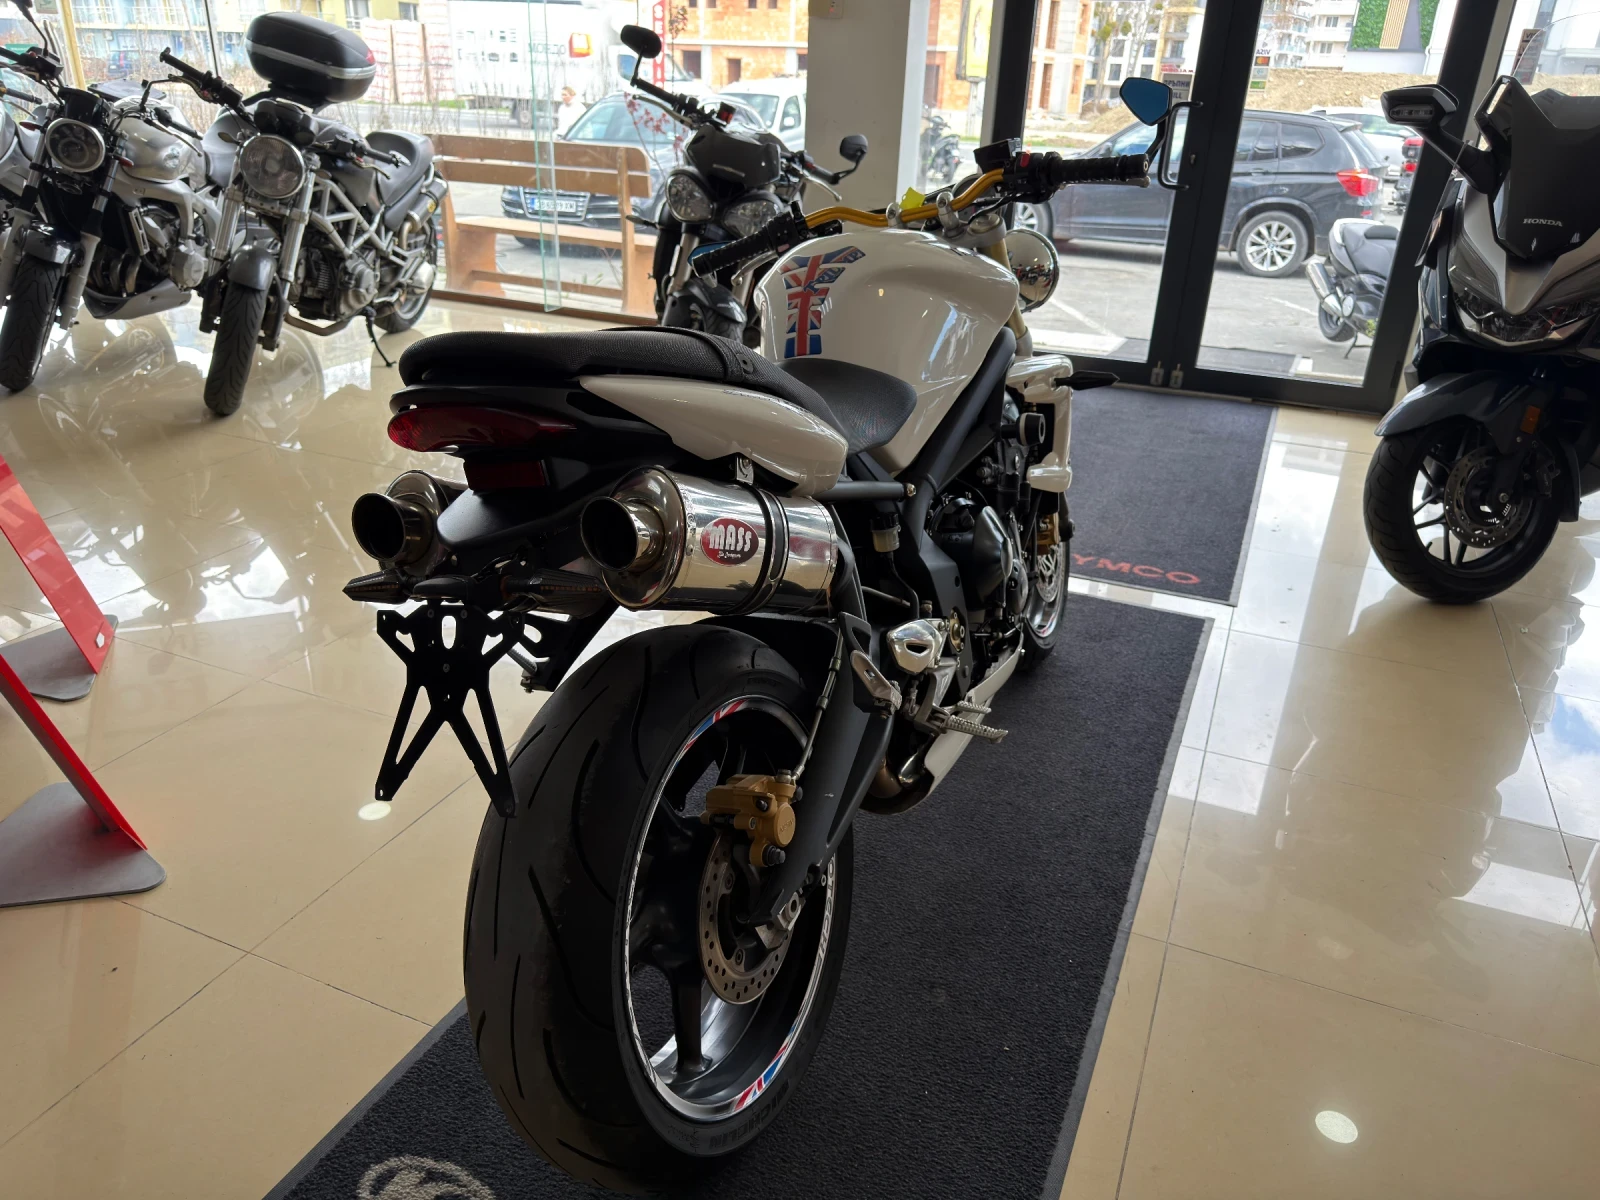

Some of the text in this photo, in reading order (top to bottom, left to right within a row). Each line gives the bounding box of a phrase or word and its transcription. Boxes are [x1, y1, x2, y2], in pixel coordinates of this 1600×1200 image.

[1523, 218, 1563, 227] HONDA
[709, 524, 752, 552] MASS
[1072, 553, 1200, 584] YMCO
